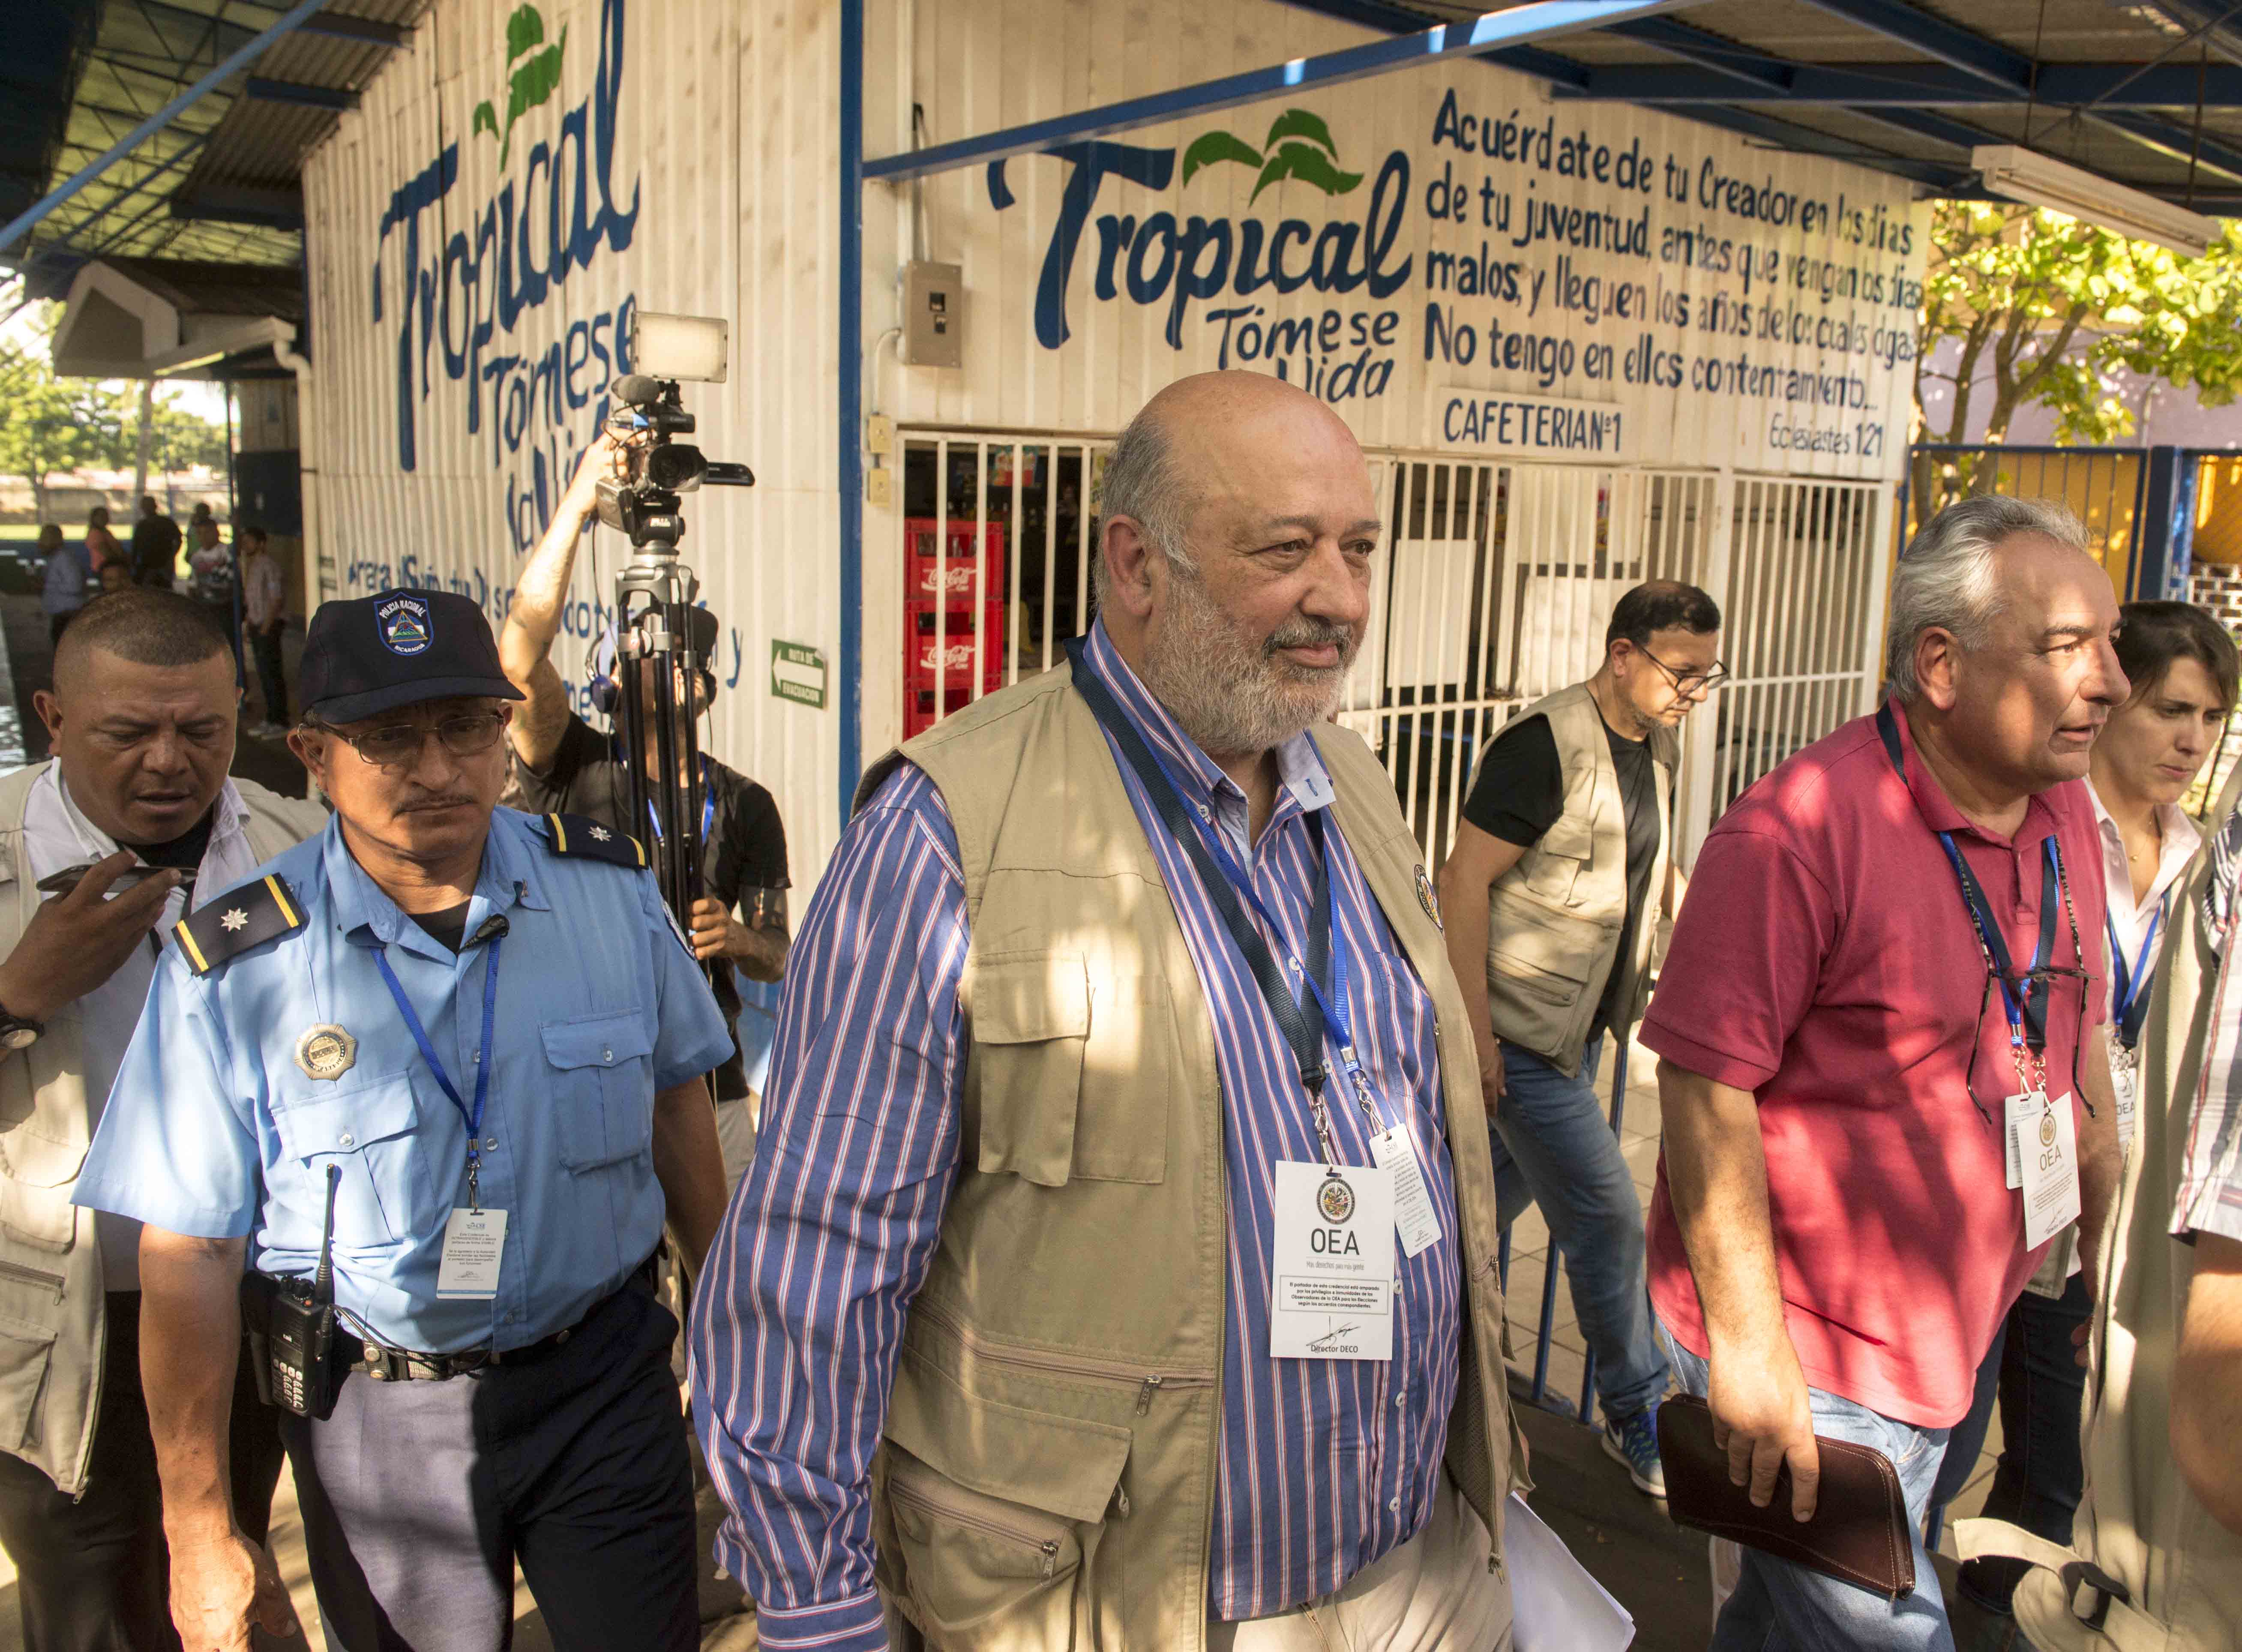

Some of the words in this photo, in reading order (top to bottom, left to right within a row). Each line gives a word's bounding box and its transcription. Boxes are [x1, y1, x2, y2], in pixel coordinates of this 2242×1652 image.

[1433, 87, 1610, 183] Acuérdate
[1616, 136, 1653, 193] de
[1664, 153, 1688, 202] tu
[1698, 155, 1798, 226] Creador
[1801, 198, 1828, 236] en
[373, 0, 641, 472] Tropical
[986, 140, 1412, 351] Tropical
[1426, 160, 1468, 223] de
[1479, 175, 1510, 233] tu
[1512, 178, 1652, 263] juventud,
[1661, 223, 1732, 273] antes
[1737, 243, 1779, 295] que
[1787, 253, 1858, 304] vengan
[1427, 241, 1522, 306] malos,
[1528, 269, 1546, 318] y
[1554, 254, 1646, 324] lleguen
[1655, 272, 1690, 327] los
[1698, 290, 1752, 337] años
[1757, 294, 1783, 341] de
[1205, 304, 1399, 369] Tómese
[1425, 302, 1477, 366] No
[1489, 317, 1575, 388] tengo
[1583, 342, 1614, 381] en
[483, 292, 637, 469] Tómese
[379, 601, 400, 619] POLICIA
[399, 600, 426, 617] NACIONAL
[394, 643, 426, 653] NICARAGUA
[2040, 1145, 2062, 1171] OEA
[1311, 1228, 1360, 1255] OEA
[1311, 1344, 1338, 1352] Director
